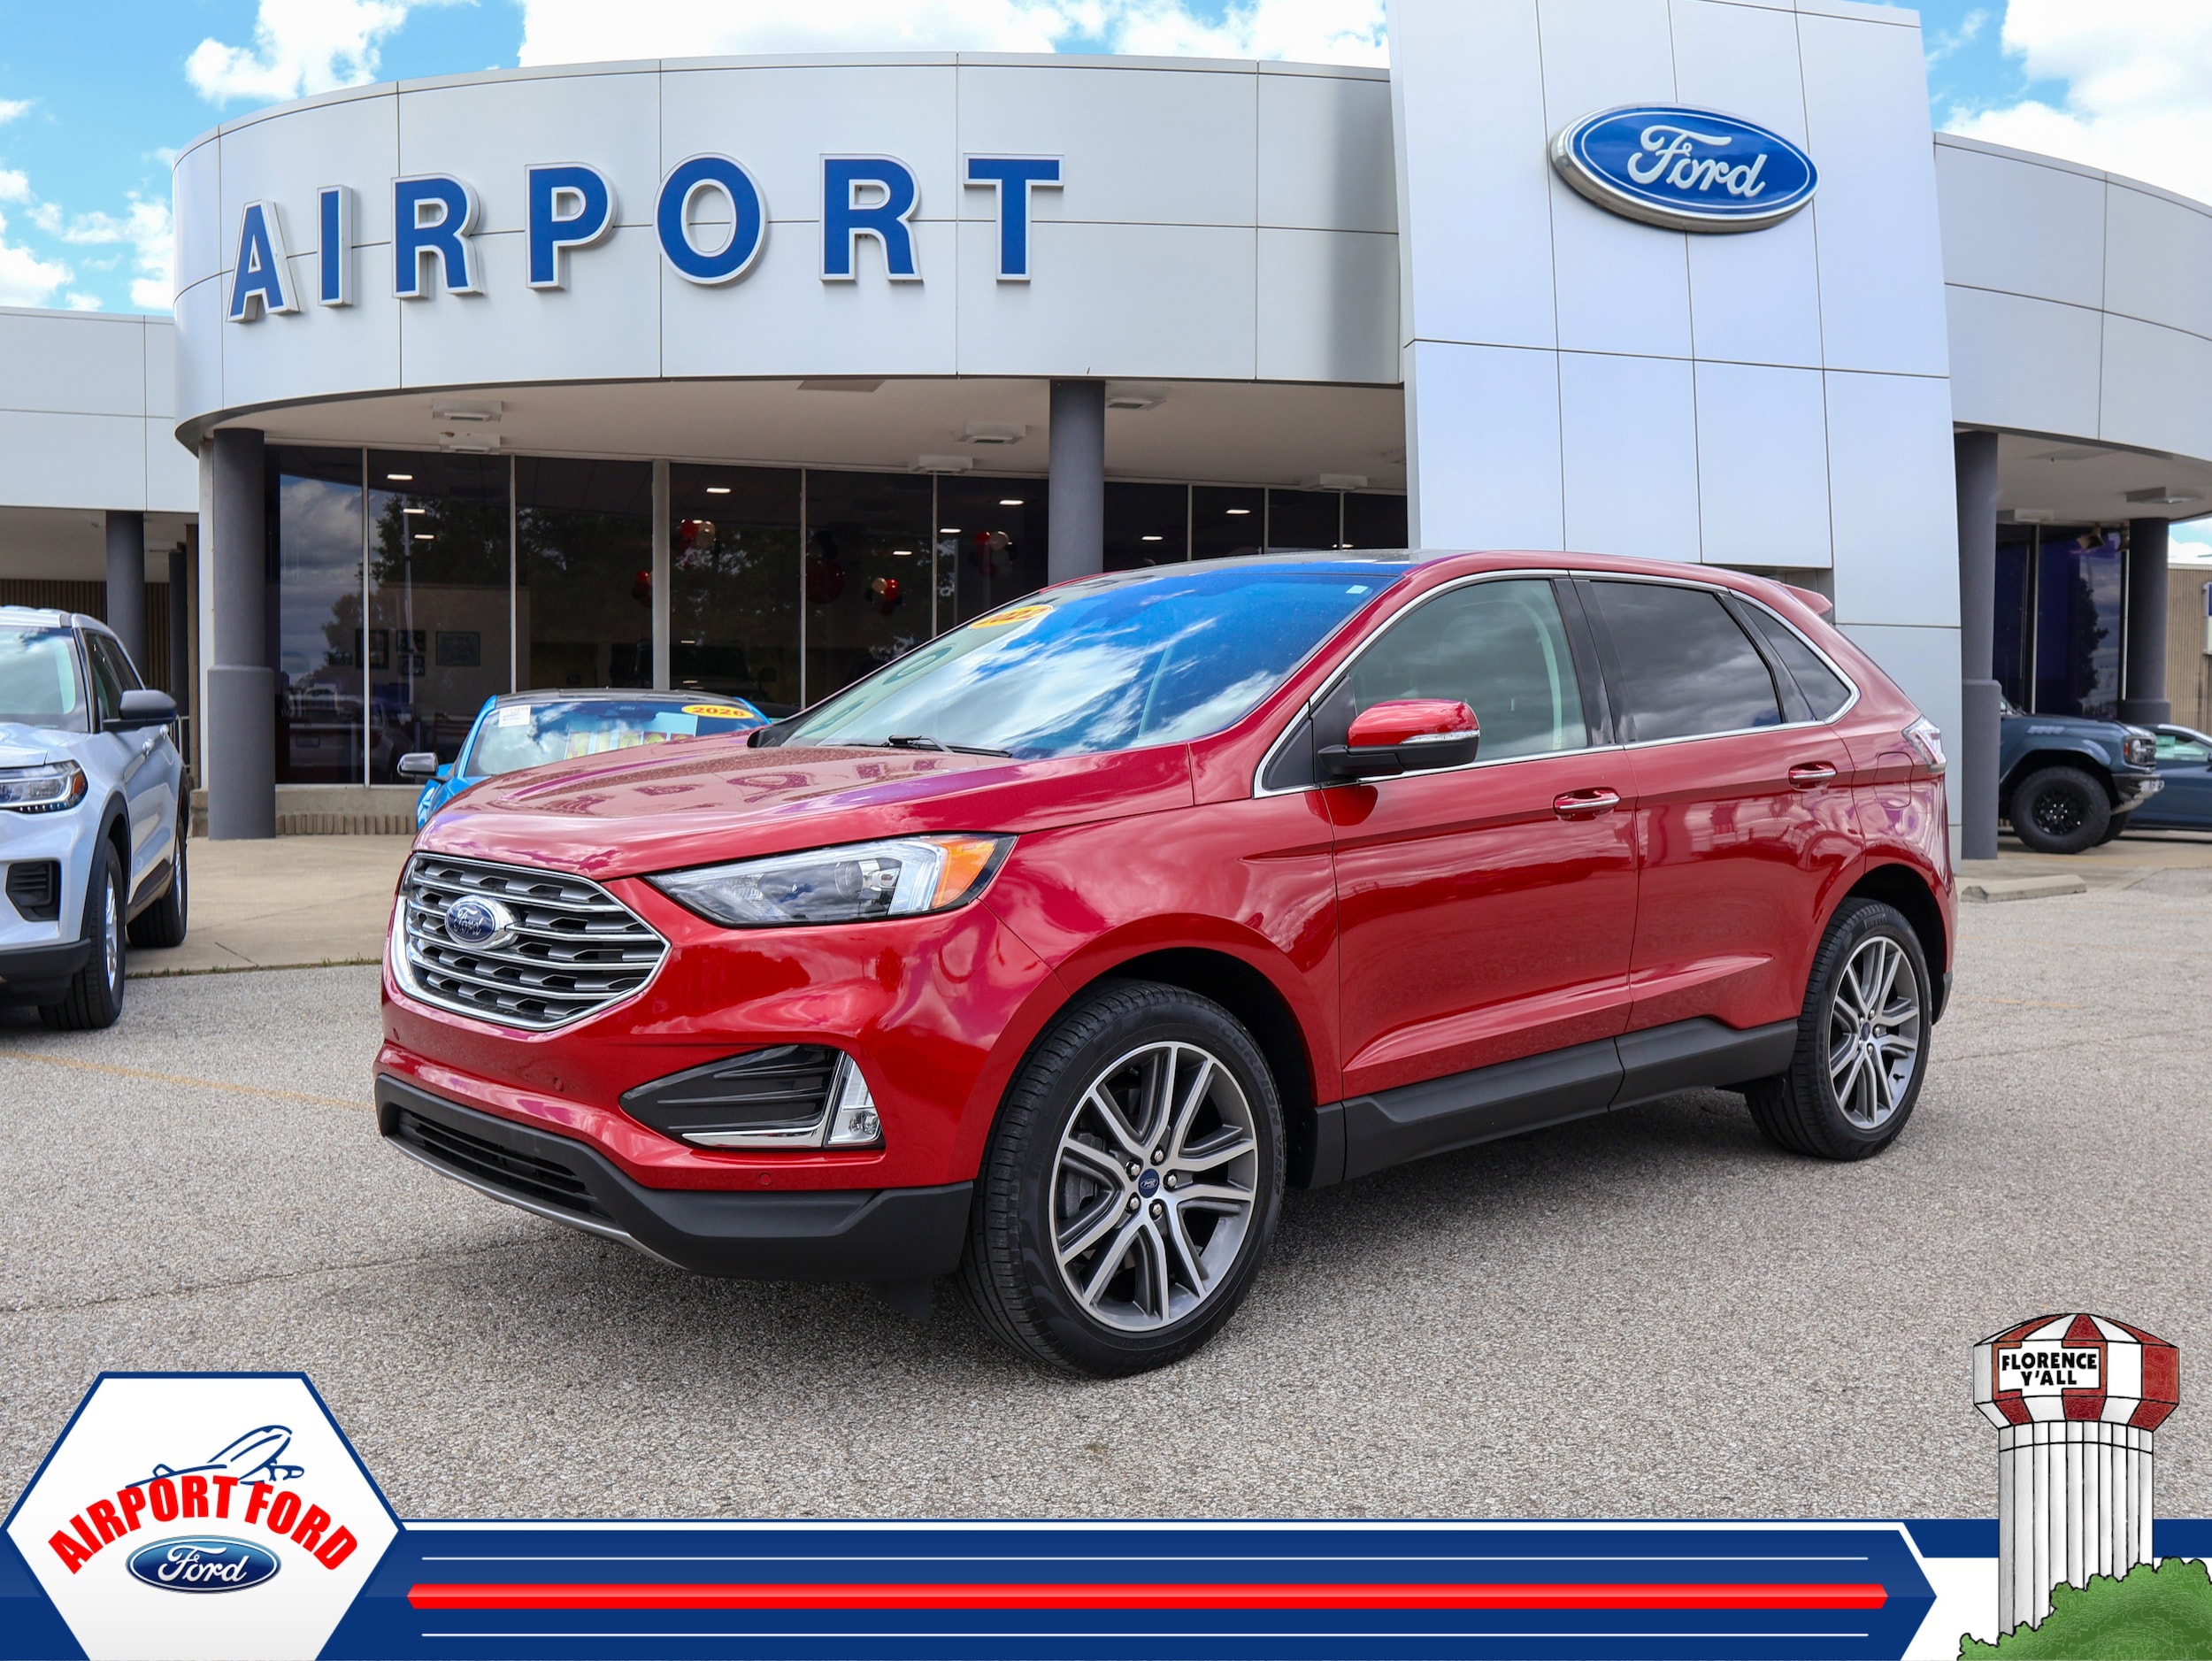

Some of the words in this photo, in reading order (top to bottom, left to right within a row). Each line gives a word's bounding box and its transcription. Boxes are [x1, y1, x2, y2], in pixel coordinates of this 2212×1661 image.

[1627, 124, 1768, 197] Ford
[226, 151, 1064, 323] AIRPORT
[692, 706, 745, 717] 2026
[453, 906, 482, 935] Ford
